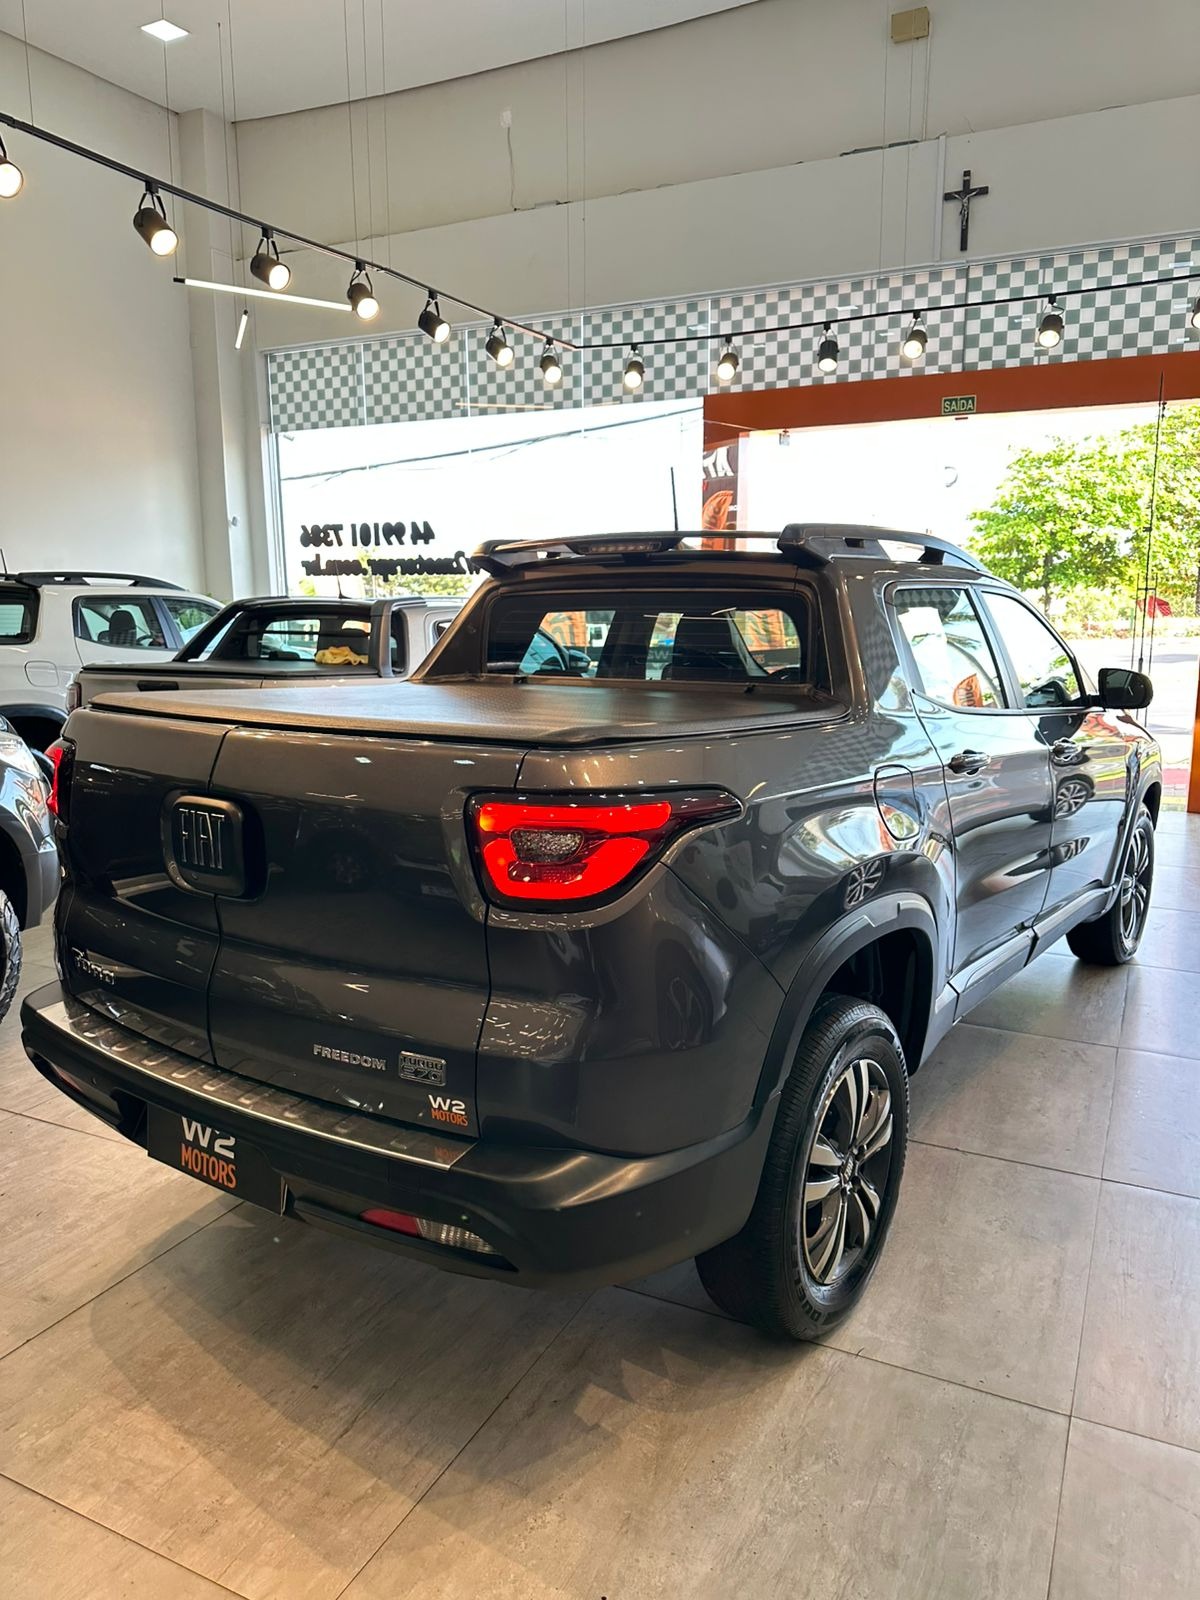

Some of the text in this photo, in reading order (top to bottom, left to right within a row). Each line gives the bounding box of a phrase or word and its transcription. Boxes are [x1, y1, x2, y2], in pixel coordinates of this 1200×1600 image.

[944, 397, 974, 412] SAÍDA
[179, 808, 225, 869] FIAT
[313, 1044, 387, 1071] FREEDOM
[400, 1056, 443, 1071] TURBO
[428, 1094, 466, 1115] W2
[431, 1109, 468, 1127] MOTORS
[181, 1116, 236, 1159] W2
[181, 1143, 237, 1189] MOTORS
